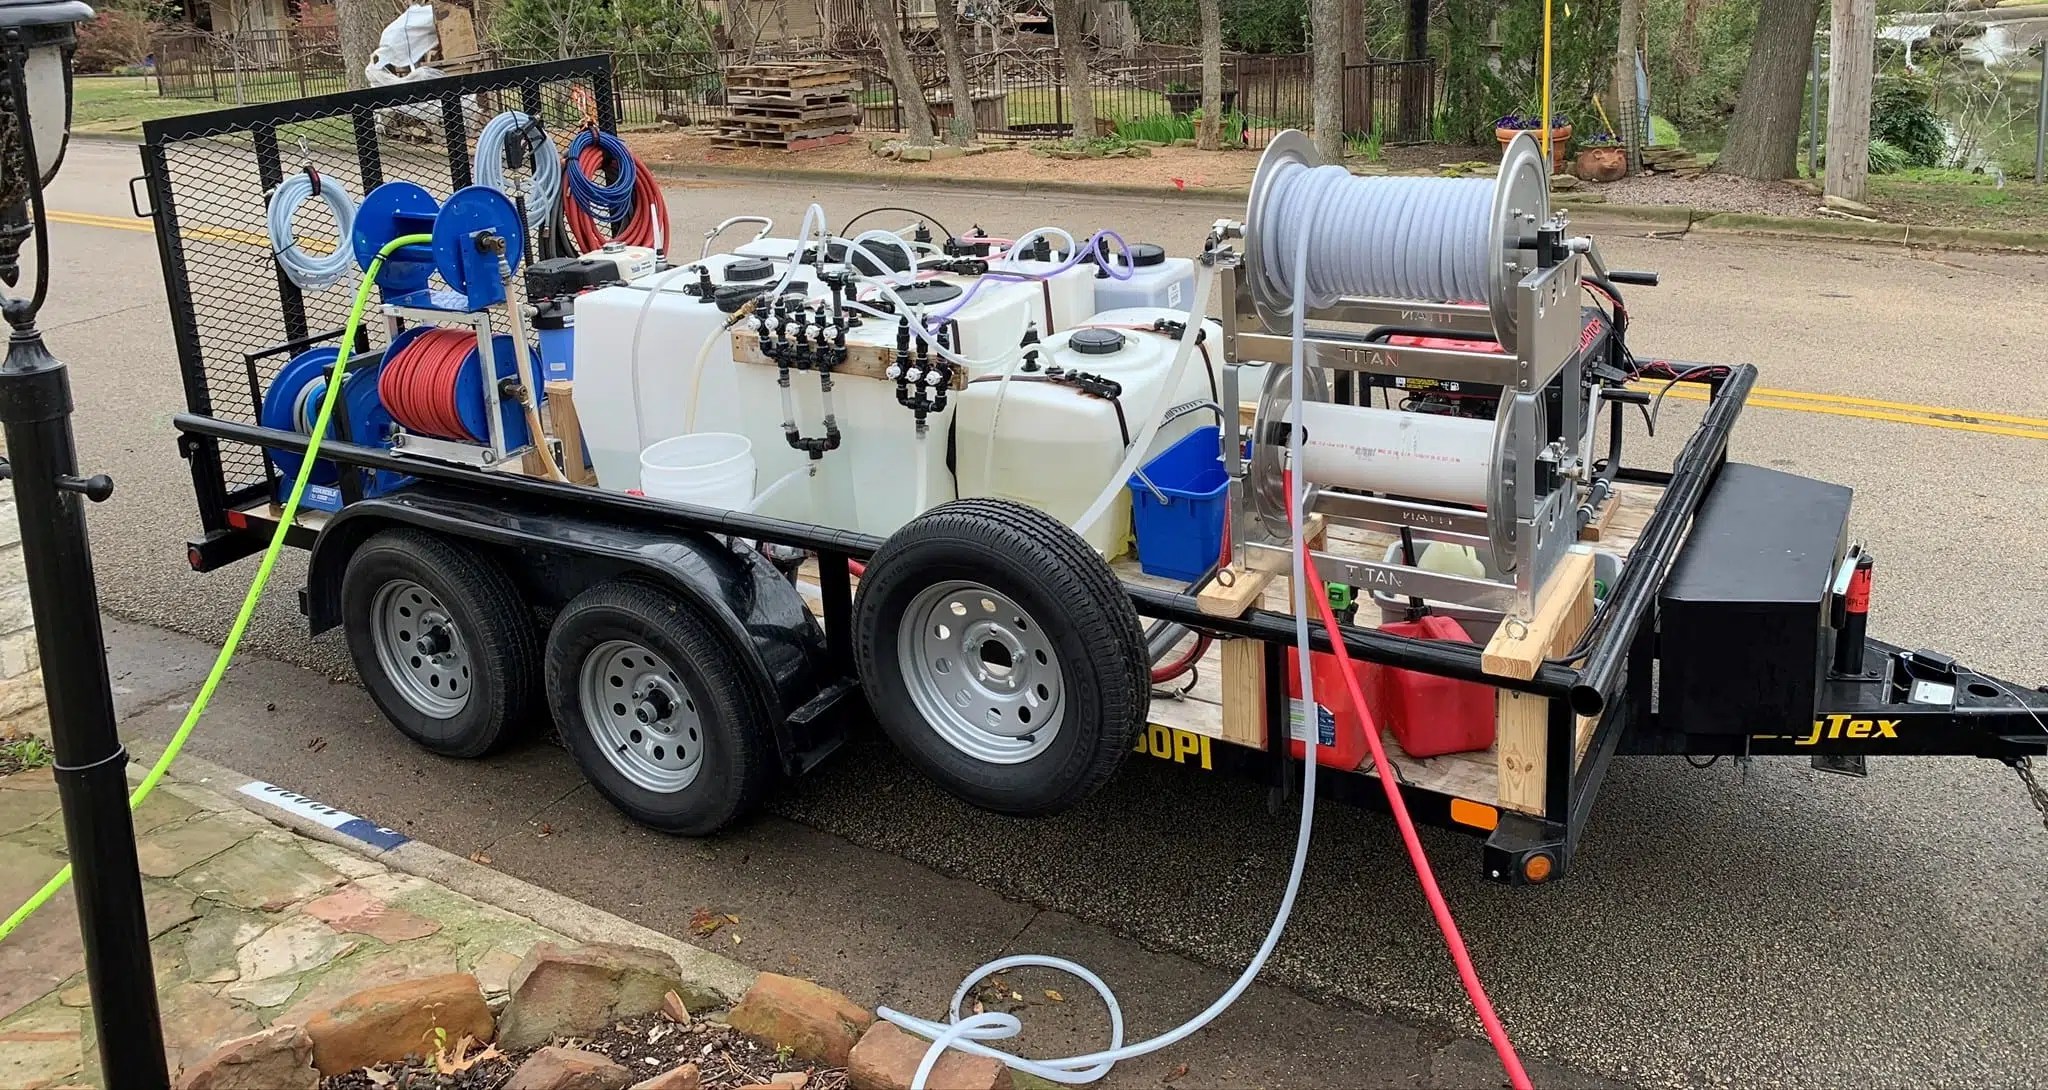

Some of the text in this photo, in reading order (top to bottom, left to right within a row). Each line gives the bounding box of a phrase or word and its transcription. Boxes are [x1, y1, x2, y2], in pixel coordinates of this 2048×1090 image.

[1339, 347, 1400, 368] TITAN
[1344, 564, 1403, 588] TITAN
[1752, 714, 1902, 746] gTex
